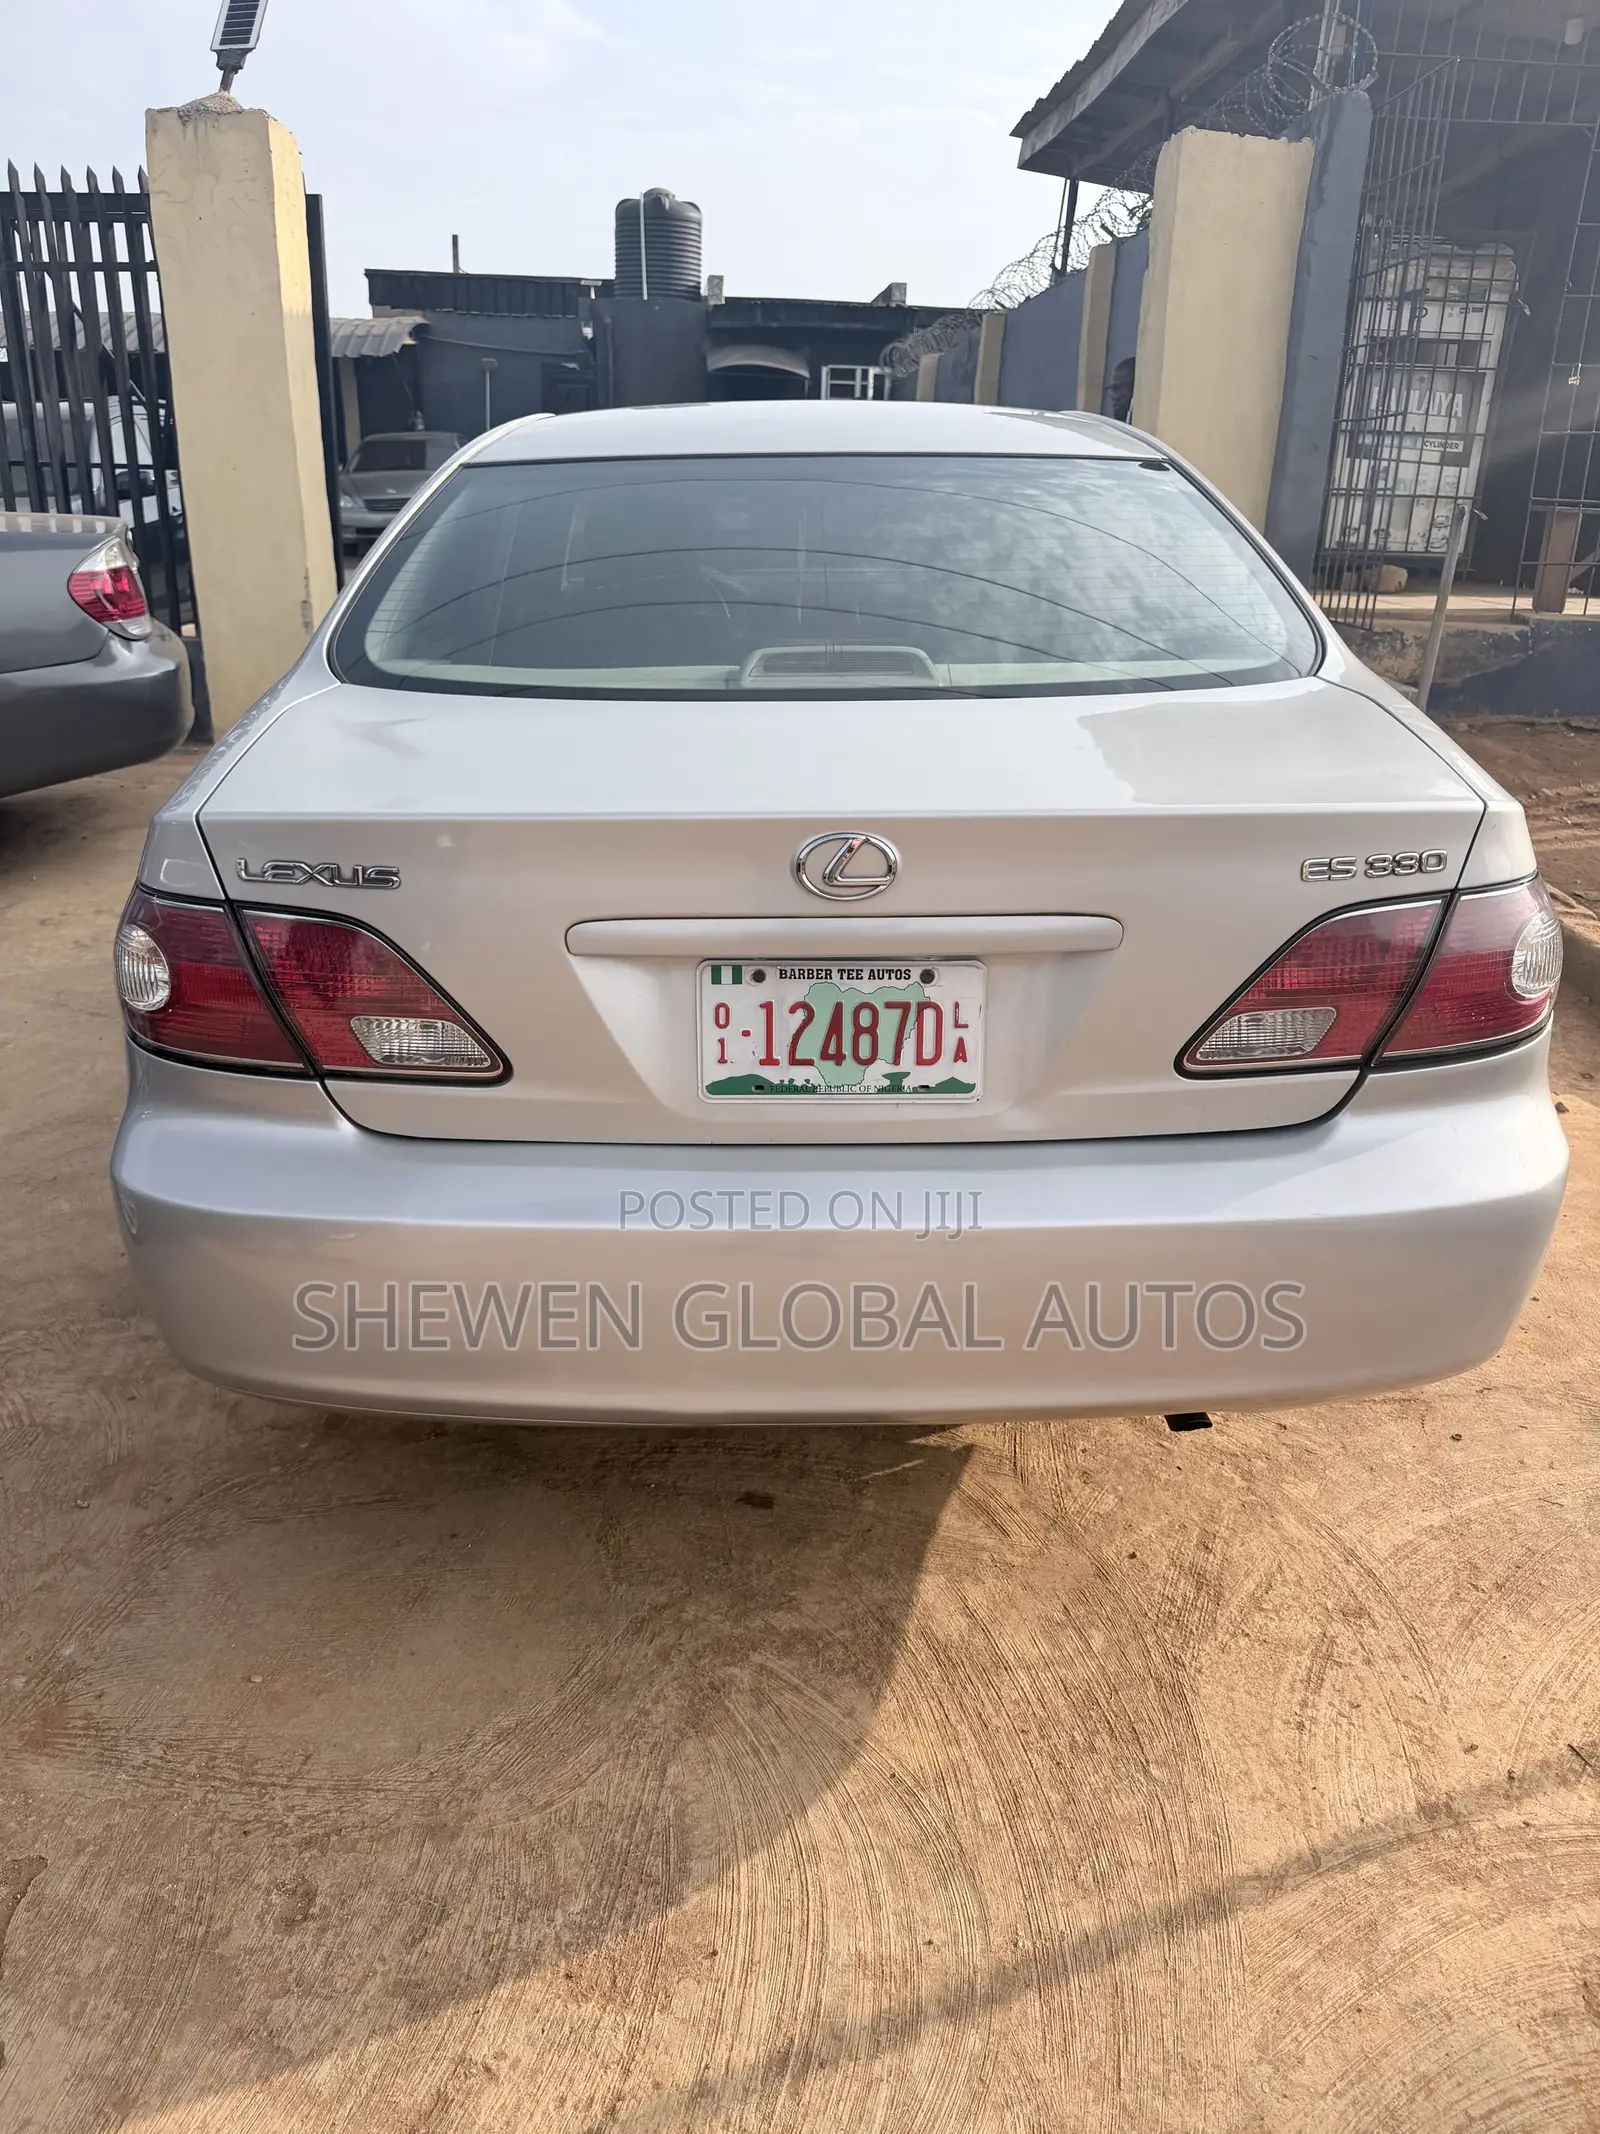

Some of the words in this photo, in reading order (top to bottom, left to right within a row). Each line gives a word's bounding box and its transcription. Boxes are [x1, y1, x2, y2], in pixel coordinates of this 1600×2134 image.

[1424, 440, 1460, 450] CYLINDER
[1302, 856, 1357, 882] ES
[1364, 849, 1448, 879] 330
[236, 858, 401, 890] LEXUS
[779, 968, 833, 980] BARBER
[837, 968, 864, 980] TEE
[867, 968, 912, 980] AUTOS
[770, 1084, 809, 1093] FEDERAL
[812, 1084, 857, 1093] REPUBLIC
[859, 1084, 872, 1093] OF
[873, 1084, 913, 1093] NIGERIA
